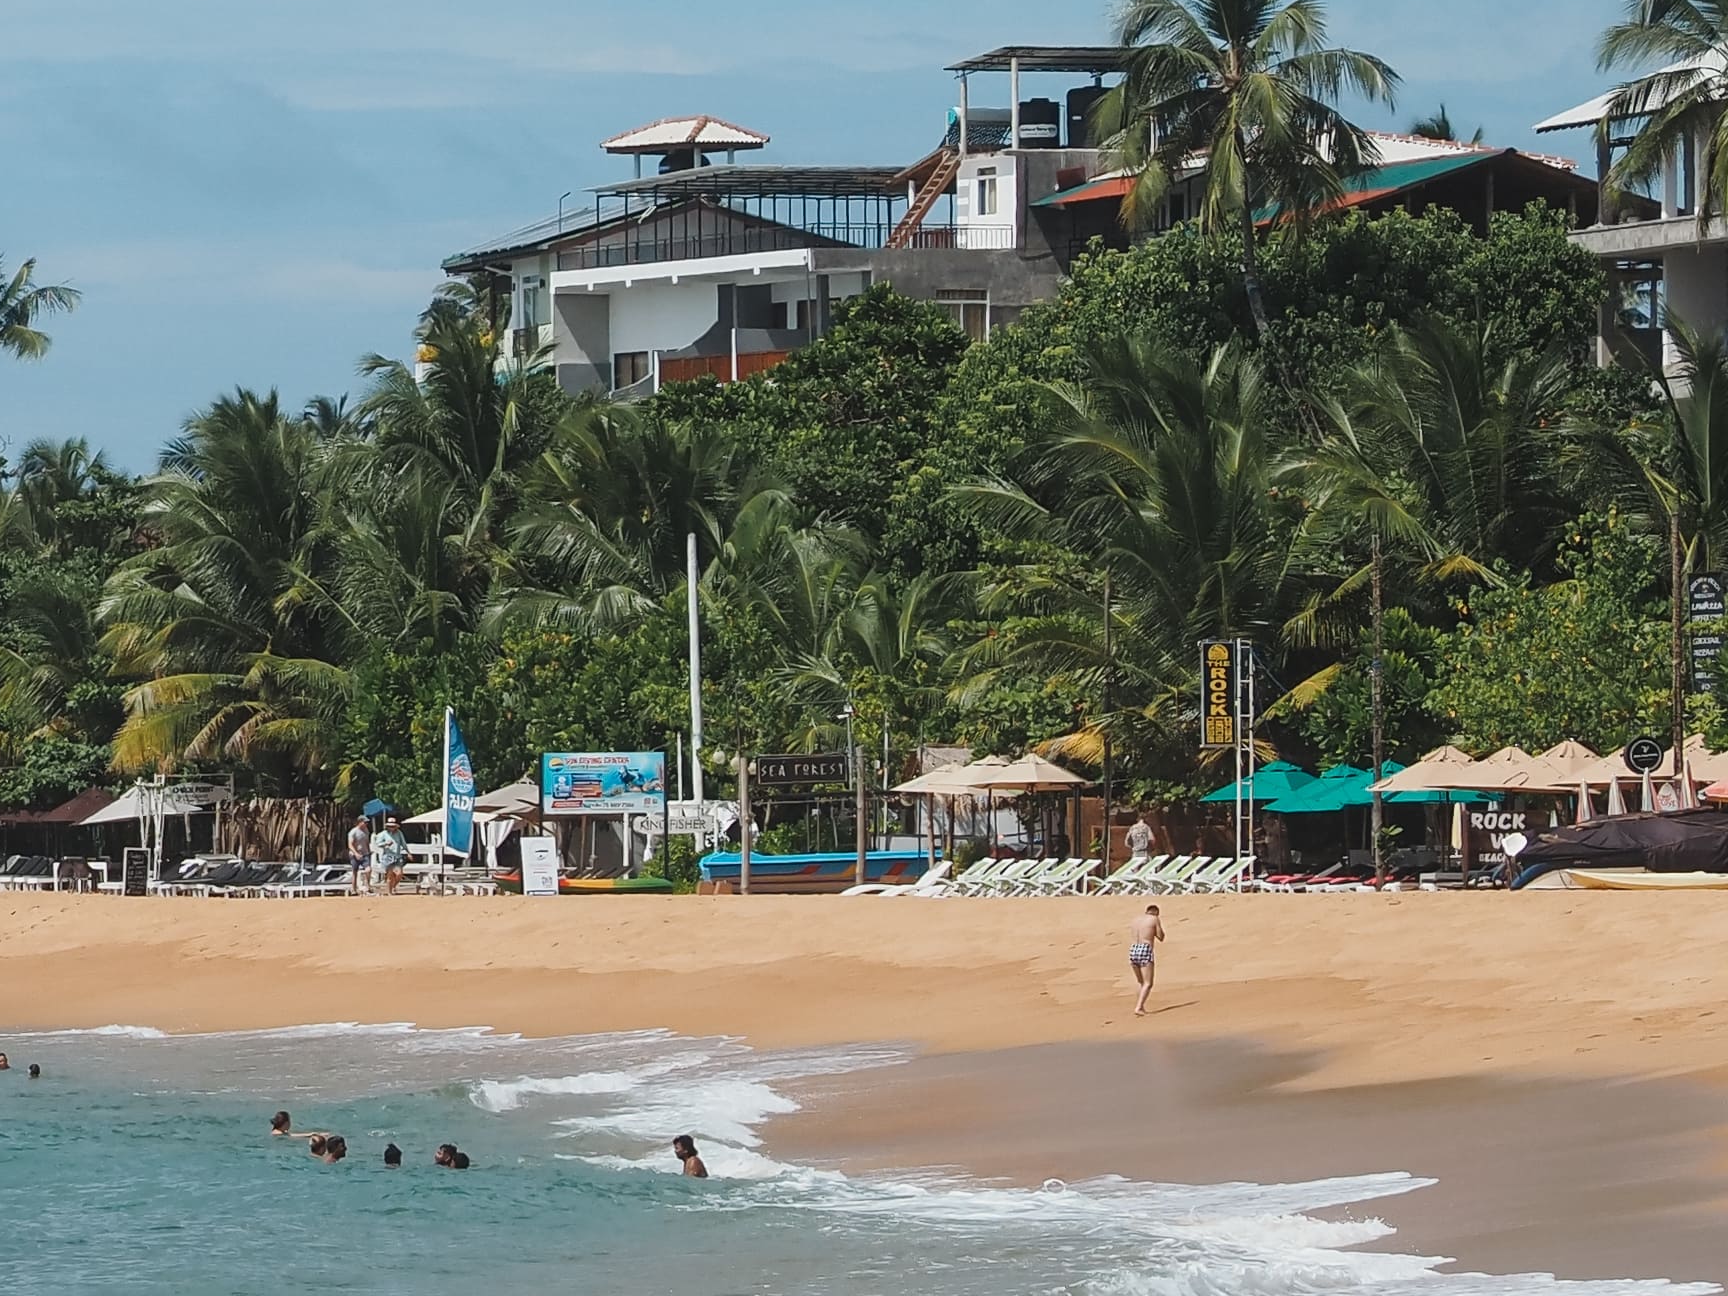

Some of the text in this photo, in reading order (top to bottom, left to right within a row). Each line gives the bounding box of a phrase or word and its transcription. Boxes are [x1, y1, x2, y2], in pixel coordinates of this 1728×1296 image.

[1209, 667, 1228, 716] ROCK
[760, 762, 844, 777] SEA FOREST
[1471, 813, 1526, 830] ROCK
